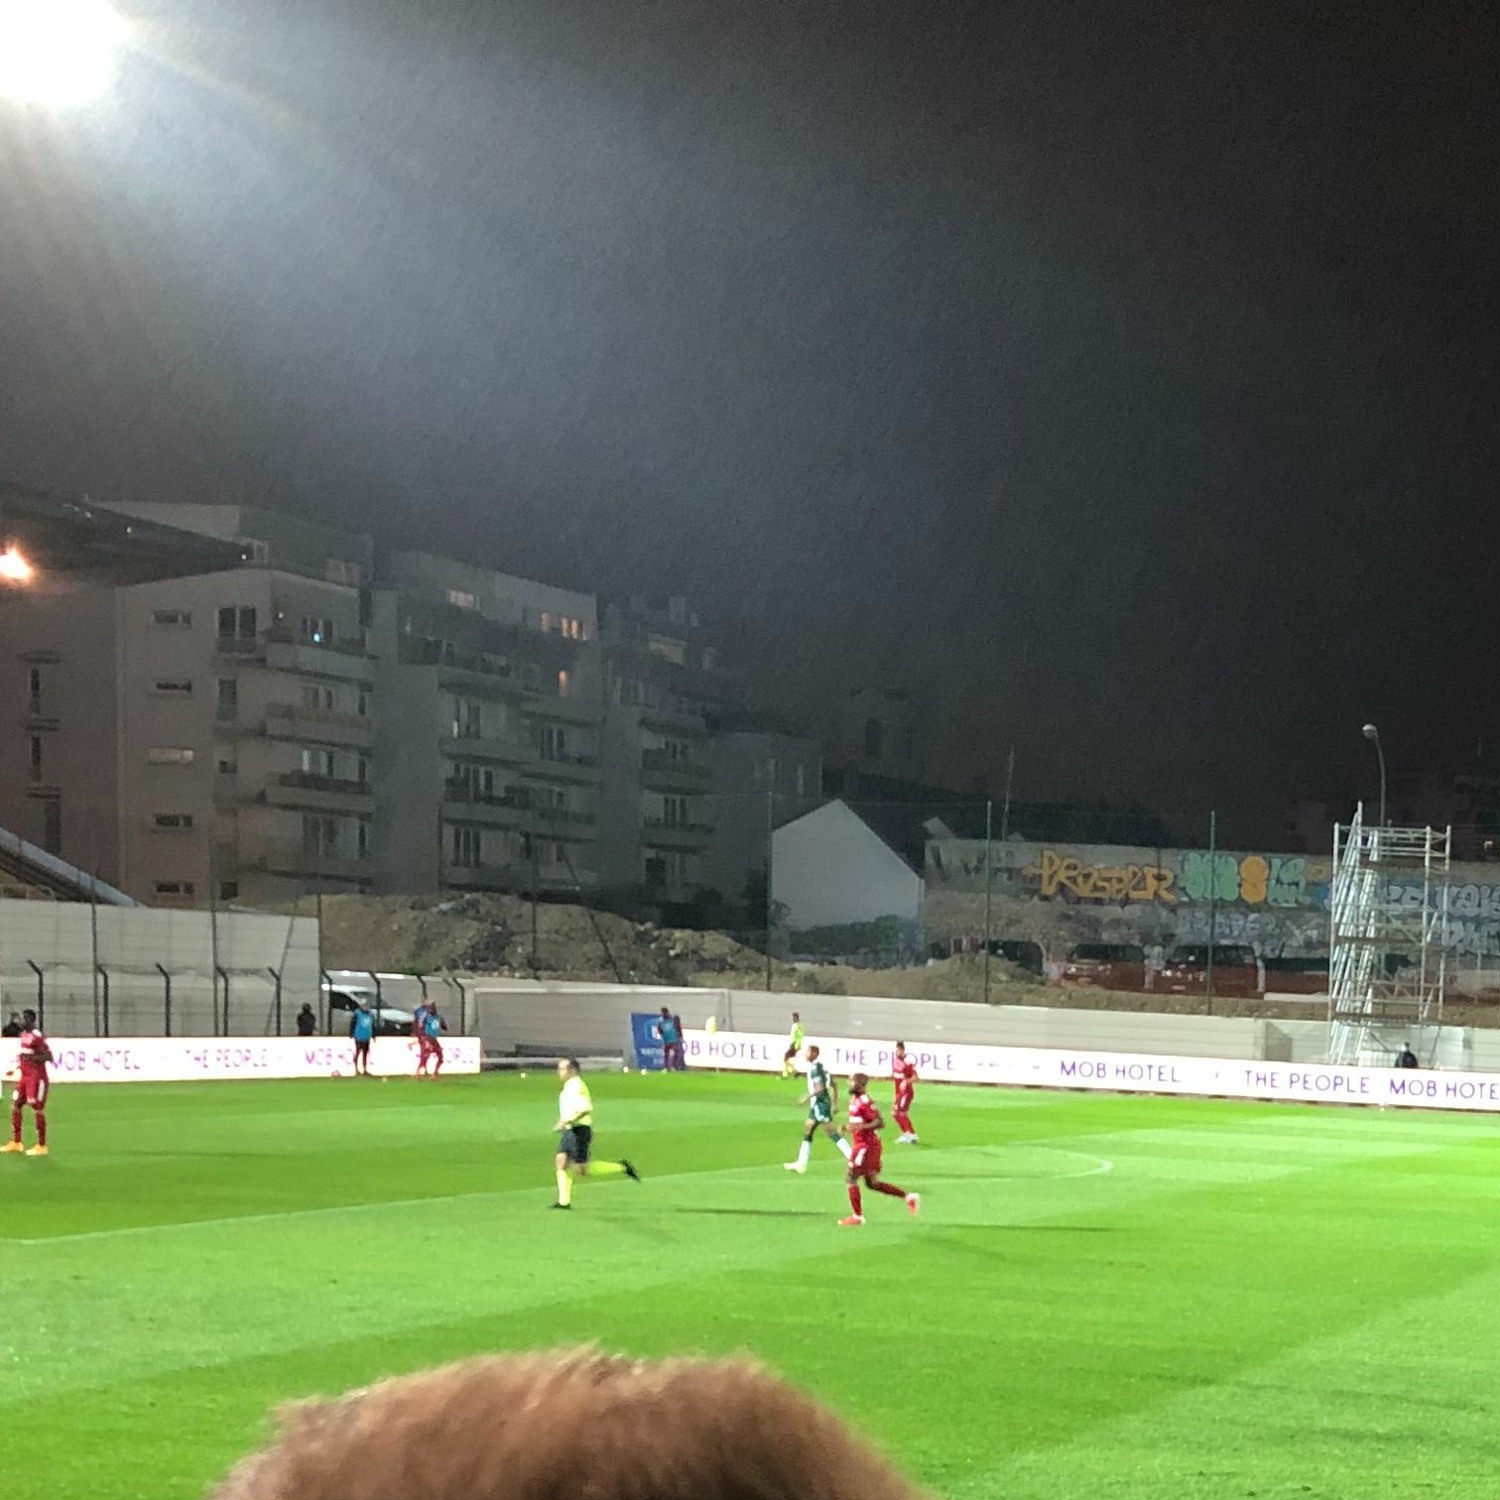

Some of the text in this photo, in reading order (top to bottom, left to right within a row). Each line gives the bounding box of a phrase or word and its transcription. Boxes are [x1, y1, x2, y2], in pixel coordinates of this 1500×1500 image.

[709, 1042, 769, 1060] HOTEL
[836, 1048, 868, 1066] THE
[1060, 1060, 1106, 1078] MOB
[1115, 1064, 1181, 1082] HOTEL
[1245, 1070, 1370, 1094] THE PEOPLE
[1389, 1078, 1437, 1097] MOB
